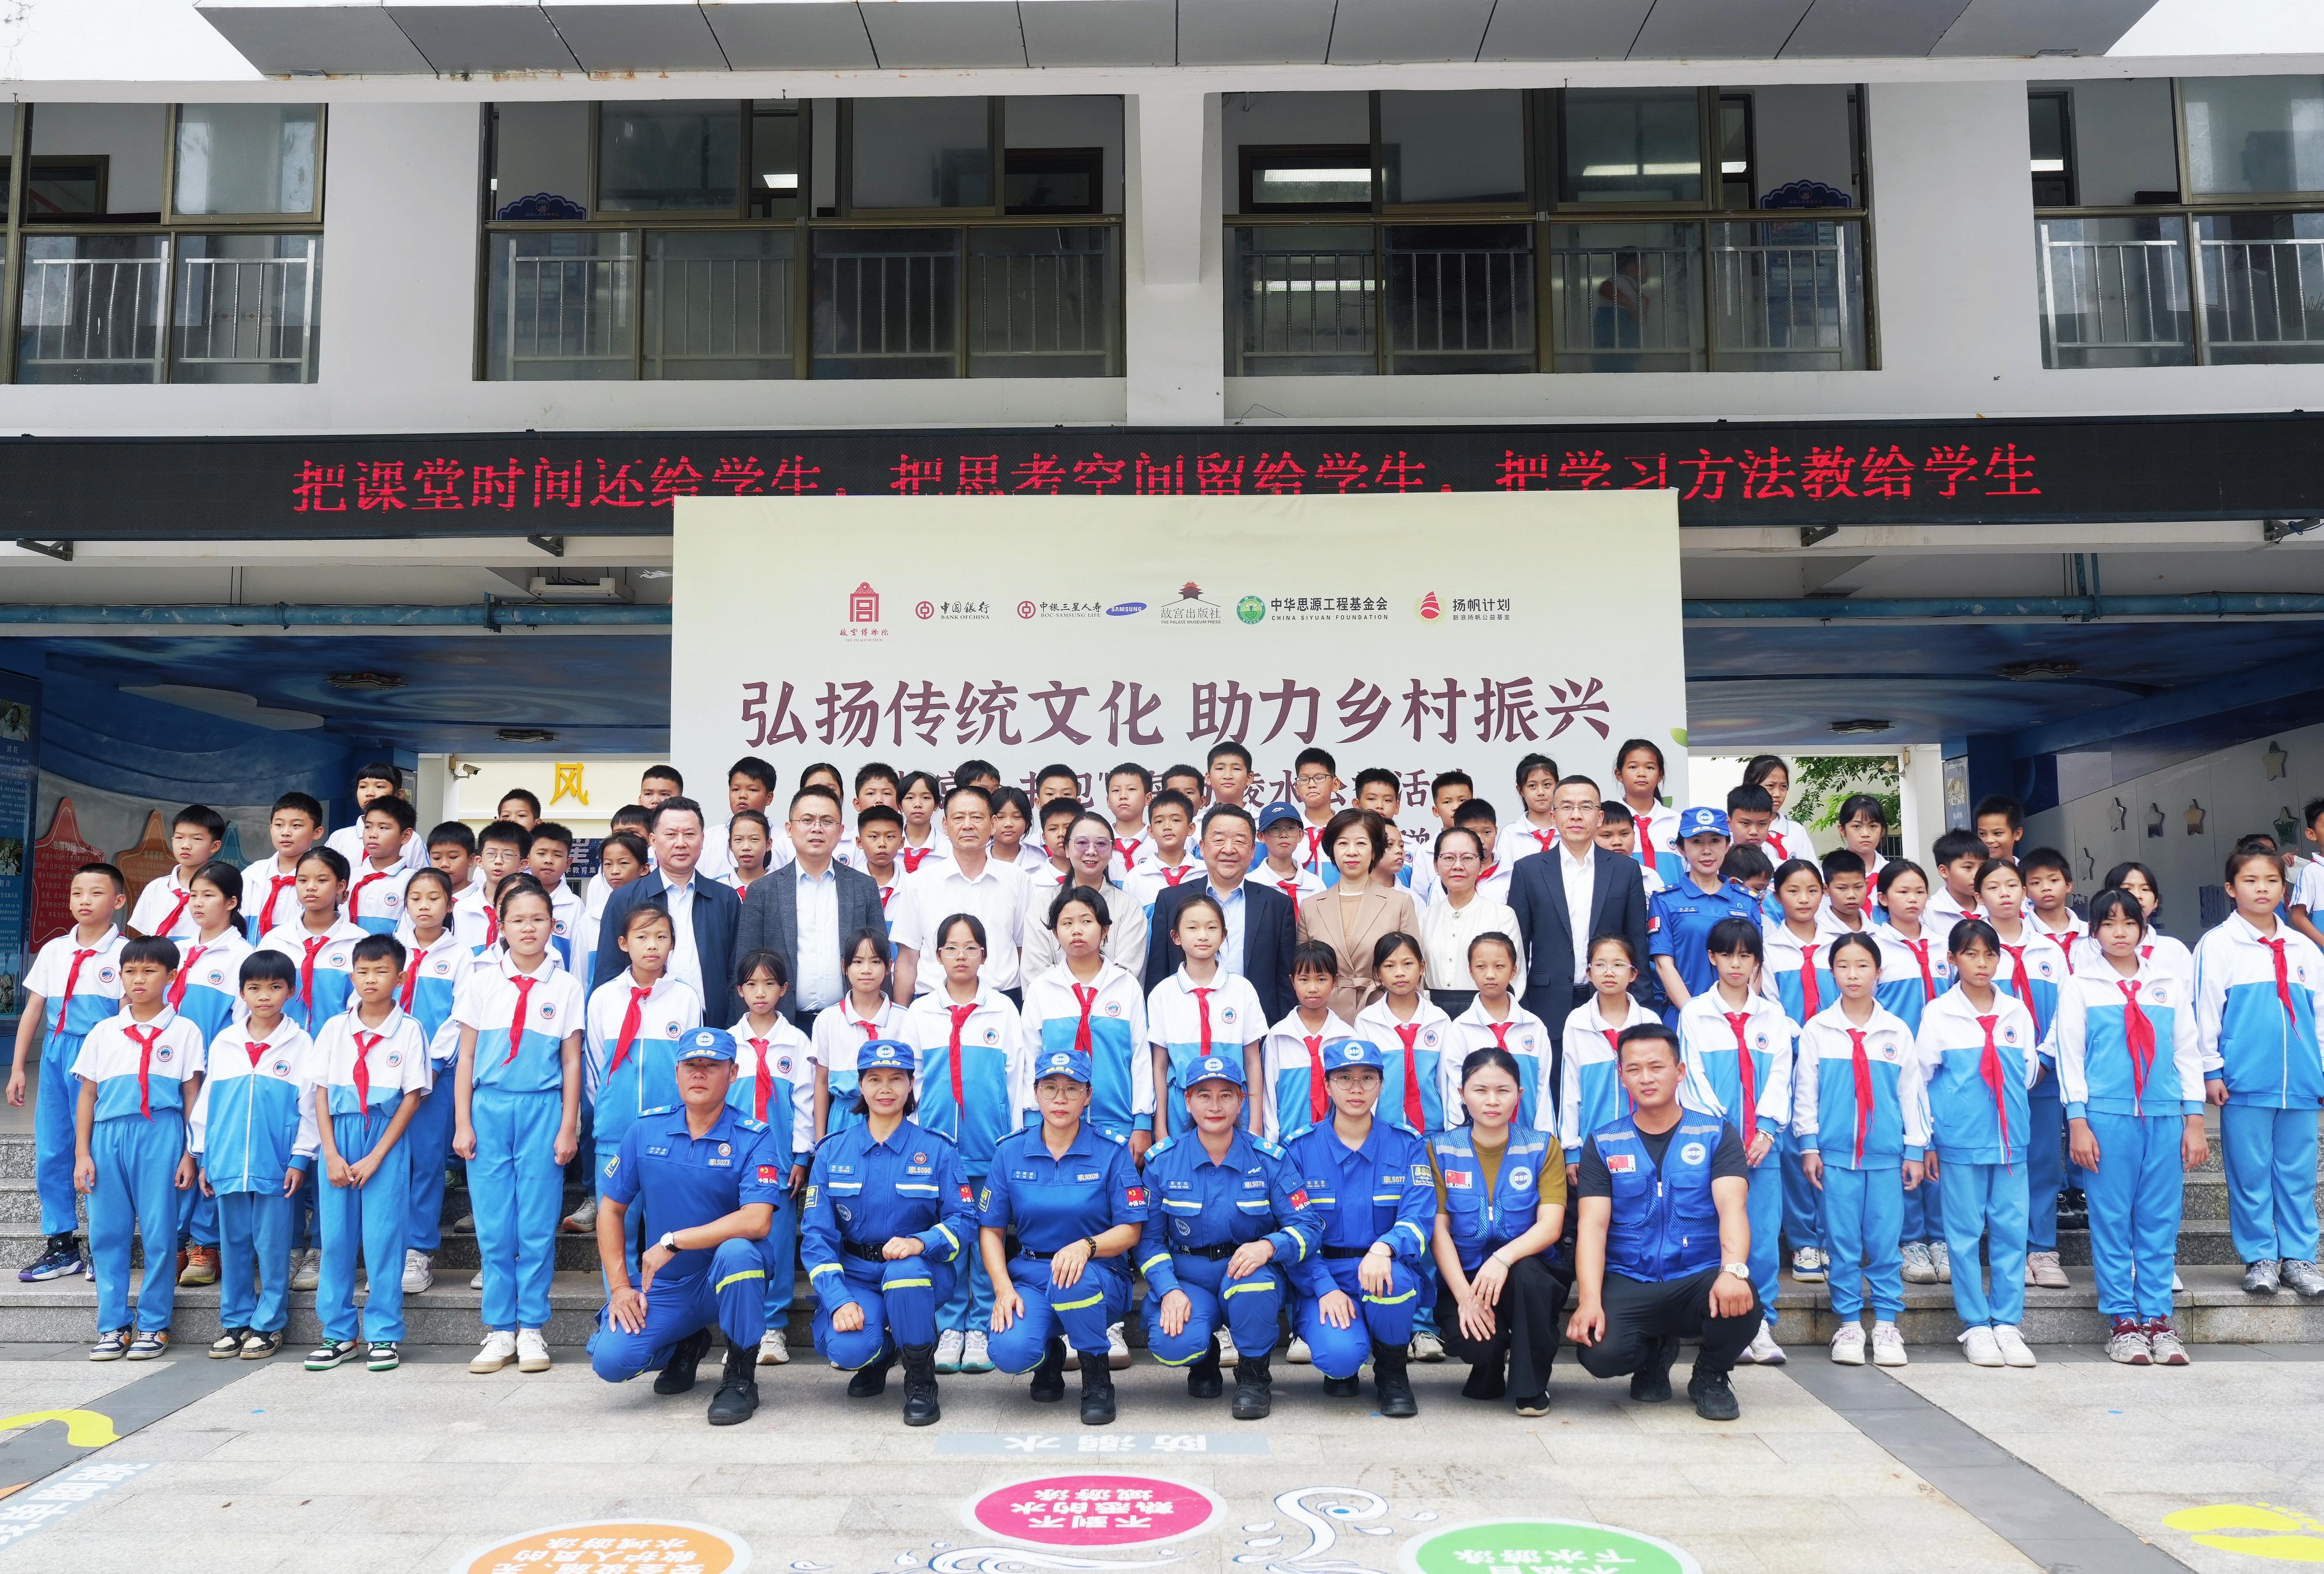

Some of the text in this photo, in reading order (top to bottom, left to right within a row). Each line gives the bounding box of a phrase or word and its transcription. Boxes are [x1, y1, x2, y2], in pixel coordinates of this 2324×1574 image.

[1040, 601, 1102, 612] 中银三星人寿
[1271, 597, 1388, 612] 中华思源工程基金会
[1452, 598, 1510, 612] 扬帆计划
[1161, 608, 1221, 620] 故宫出版社
[840, 628, 888, 636] 故宫博物院
[742, 676, 1610, 747] 弘扬传统文化 助力乡村振兴
[549, 762, 590, 805] 风
[1003, 1434, 1207, 1453] 防溺水
[1033, 1488, 1154, 1501] 域游泳
[1010, 1501, 1174, 1514] 熟悉的水
[1028, 1514, 1152, 1529] 不到不
[544, 1538, 688, 1550] 水域游泳
[512, 1550, 697, 1563] 救护人员的
[1453, 1549, 1636, 1565] 下水游泳
